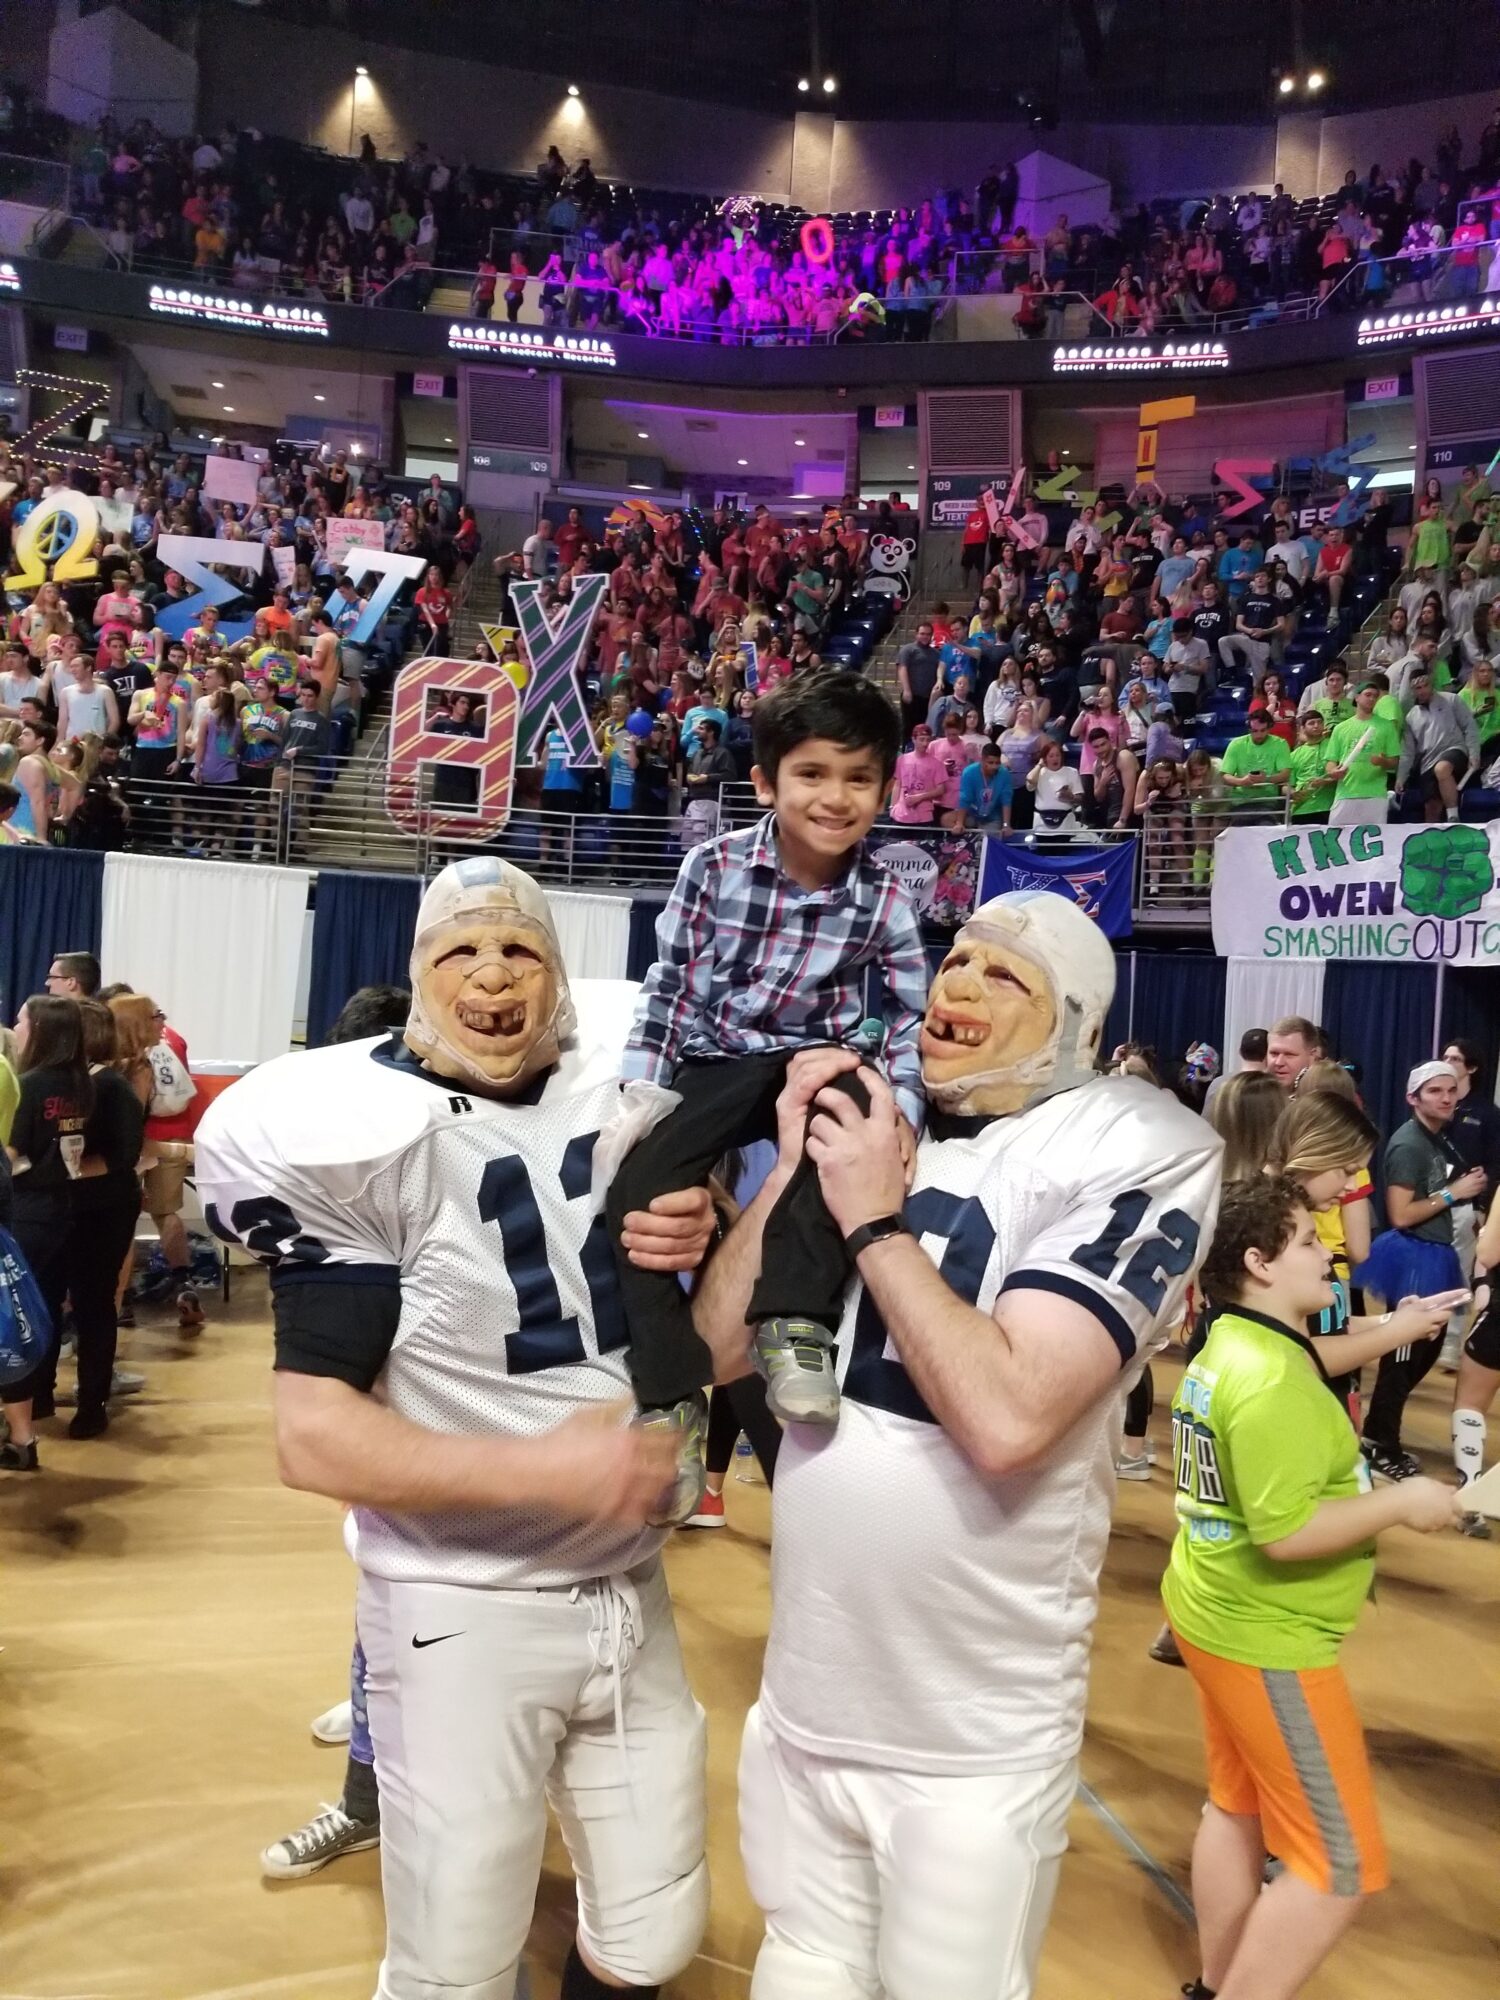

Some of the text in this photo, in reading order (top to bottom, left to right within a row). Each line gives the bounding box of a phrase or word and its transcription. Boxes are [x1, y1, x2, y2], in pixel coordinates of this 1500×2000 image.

[150, 285, 326, 322] Anderson Audio
[1358, 305, 1467, 332] Anderson
[56, 331, 86, 346] EXIT
[448, 325, 614, 353] Anderson Audio
[448, 340, 490, 351] Concert
[1357, 331, 1404, 345] Concert
[1053, 343, 1227, 360] Anderson Audio
[1053, 363, 1096, 371] Concert
[1106, 362, 1161, 370] Broadcast
[415, 380, 440, 391] EXIT
[1367, 381, 1396, 394] EXIT
[878, 411, 903, 421] EXIT
[473, 456, 548, 472] 108 109
[1433, 451, 1453, 462] 110
[933, 480, 1006, 491] 109 110
[1268, 825, 1384, 880] KKG
[1279, 881, 1397, 921] OWEN
[1263, 923, 1412, 957] SMASHING
[1412, 919, 1487, 960] OUT
[1069, 1189, 1200, 1316] 12
